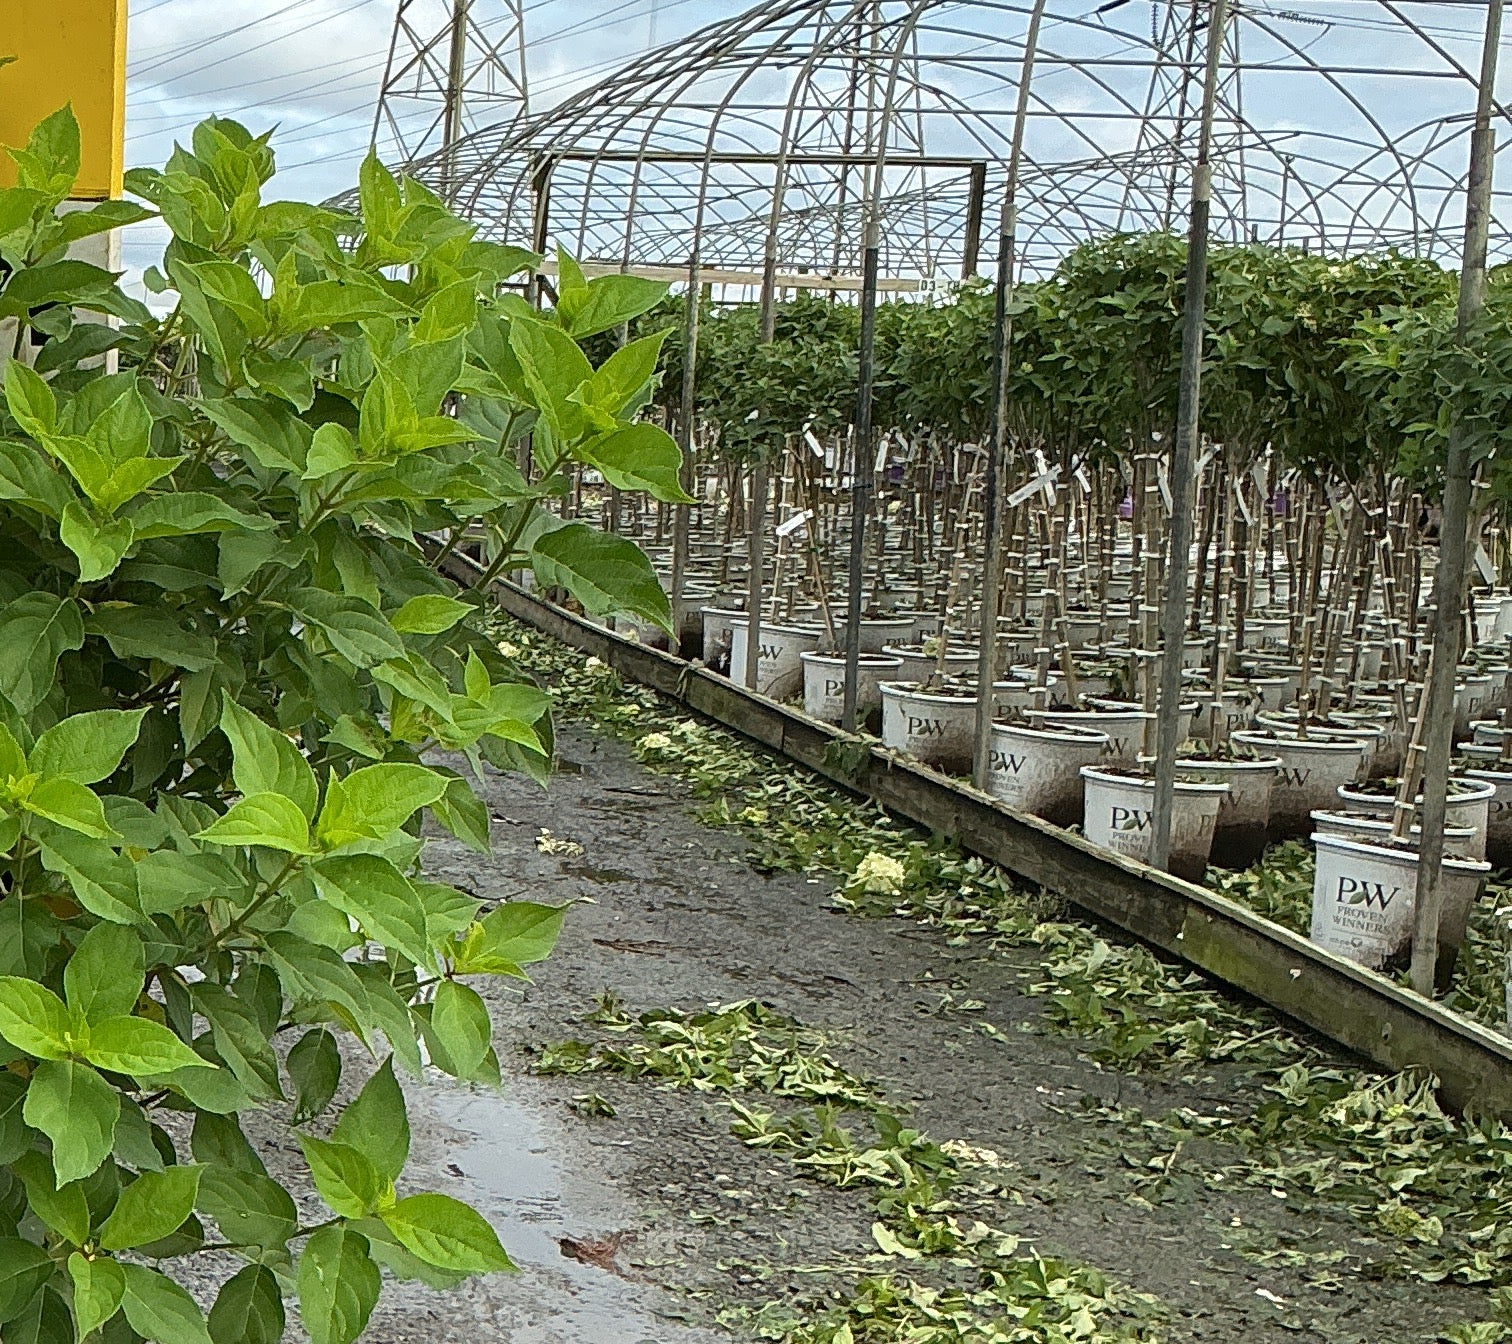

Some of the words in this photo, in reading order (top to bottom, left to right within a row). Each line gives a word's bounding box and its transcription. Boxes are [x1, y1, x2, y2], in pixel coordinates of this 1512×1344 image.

[907, 716, 952, 737] PW
[988, 749, 1027, 774] PW
[1336, 876, 1400, 912] PW
[1337, 905, 1388, 925] PROVEN
